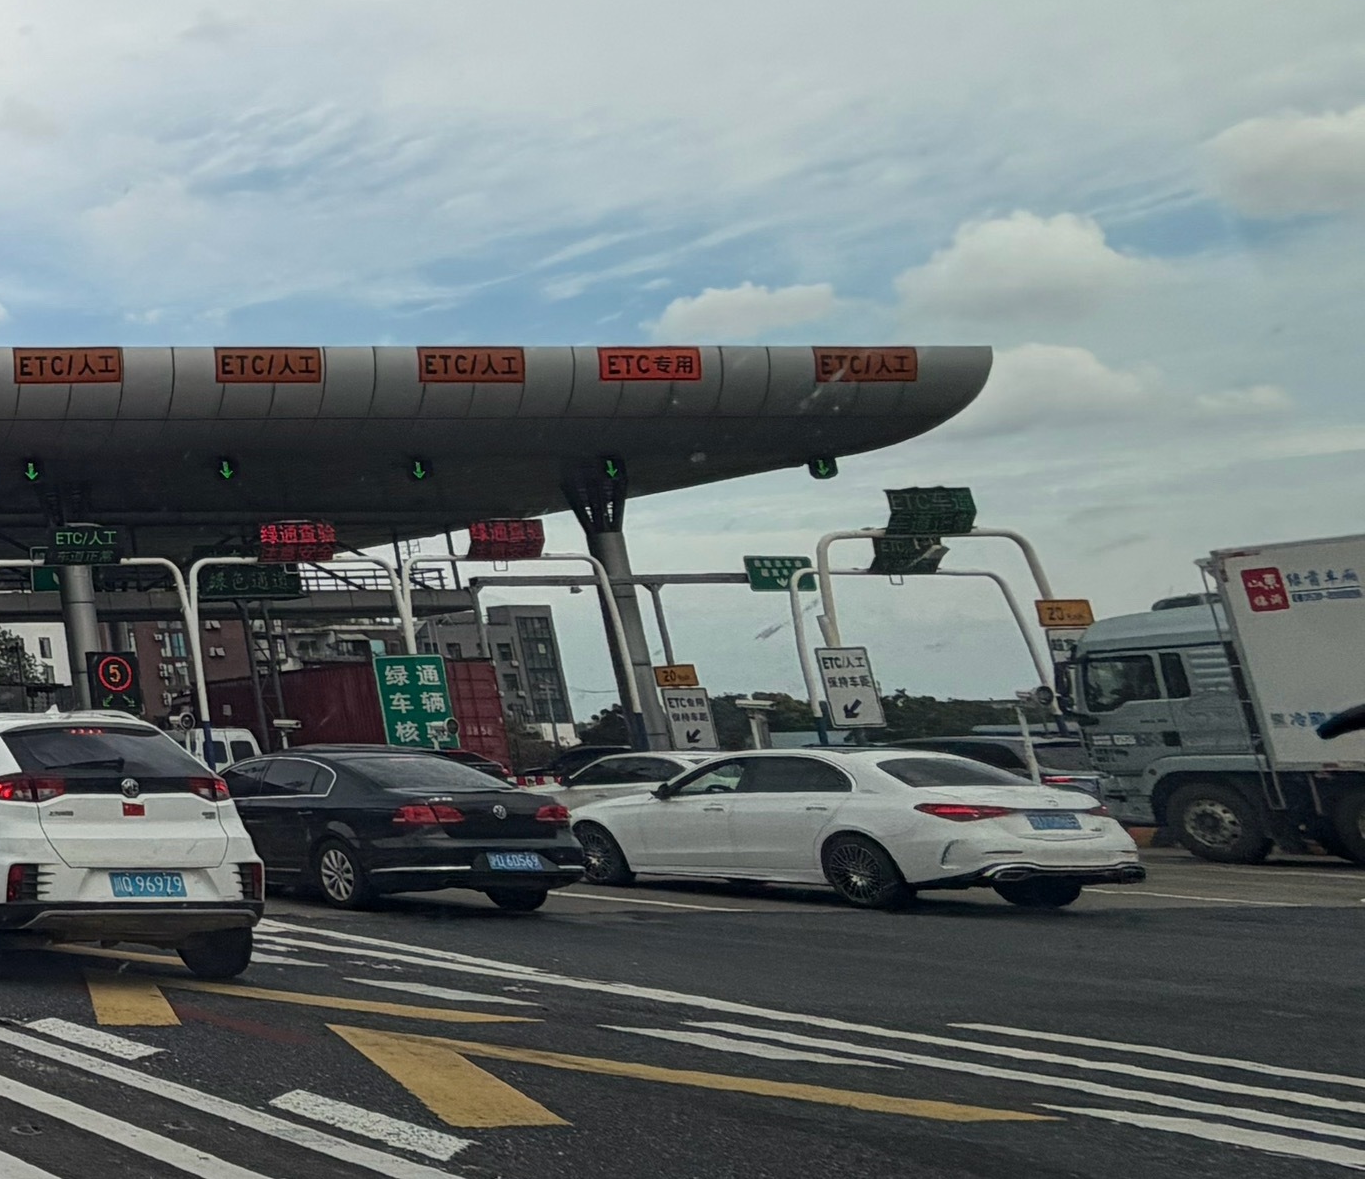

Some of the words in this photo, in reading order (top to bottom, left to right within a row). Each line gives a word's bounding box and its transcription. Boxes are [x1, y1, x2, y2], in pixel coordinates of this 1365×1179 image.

[19, 354, 116, 377] ETC/人工
[220, 354, 318, 377] ETC/人工
[424, 354, 520, 377] ETC/人工
[607, 353, 694, 376] ETC专用
[819, 354, 913, 376] ETC/人工
[55, 530, 117, 546] ETC/人工
[109, 664, 121, 683] 5
[821, 656, 866, 669] ETC/人工
[385, 665, 441, 686] 绿通
[390, 691, 446, 713] 车辆
